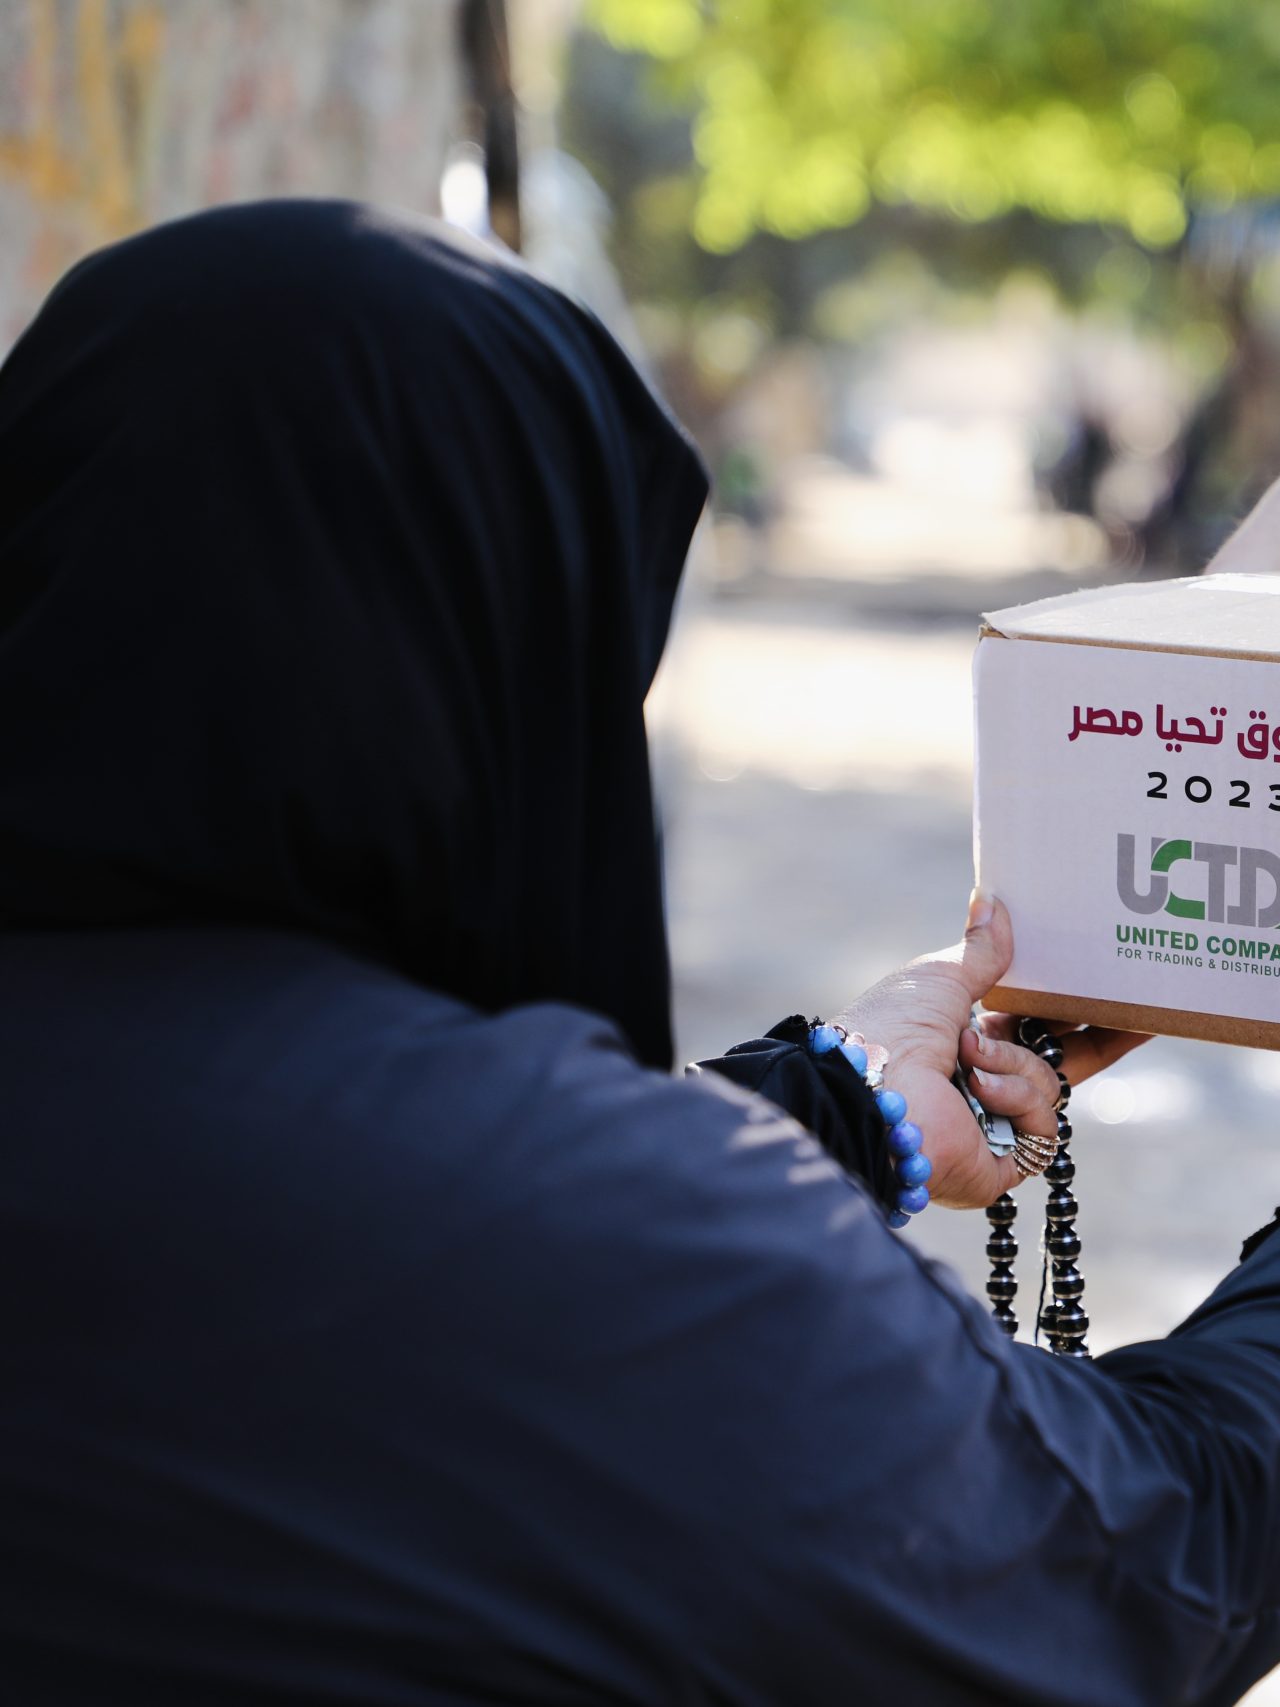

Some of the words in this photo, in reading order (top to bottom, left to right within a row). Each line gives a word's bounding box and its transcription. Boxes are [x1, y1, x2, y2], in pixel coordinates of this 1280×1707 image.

[1067, 705, 1144, 742] مصر
[1156, 704, 1228, 753] تحيا
[1116, 924, 1199, 952] UNITED
[1117, 947, 1142, 960] FOR
[1147, 950, 1203, 968] TRADING
[1208, 959, 1217, 970] &
